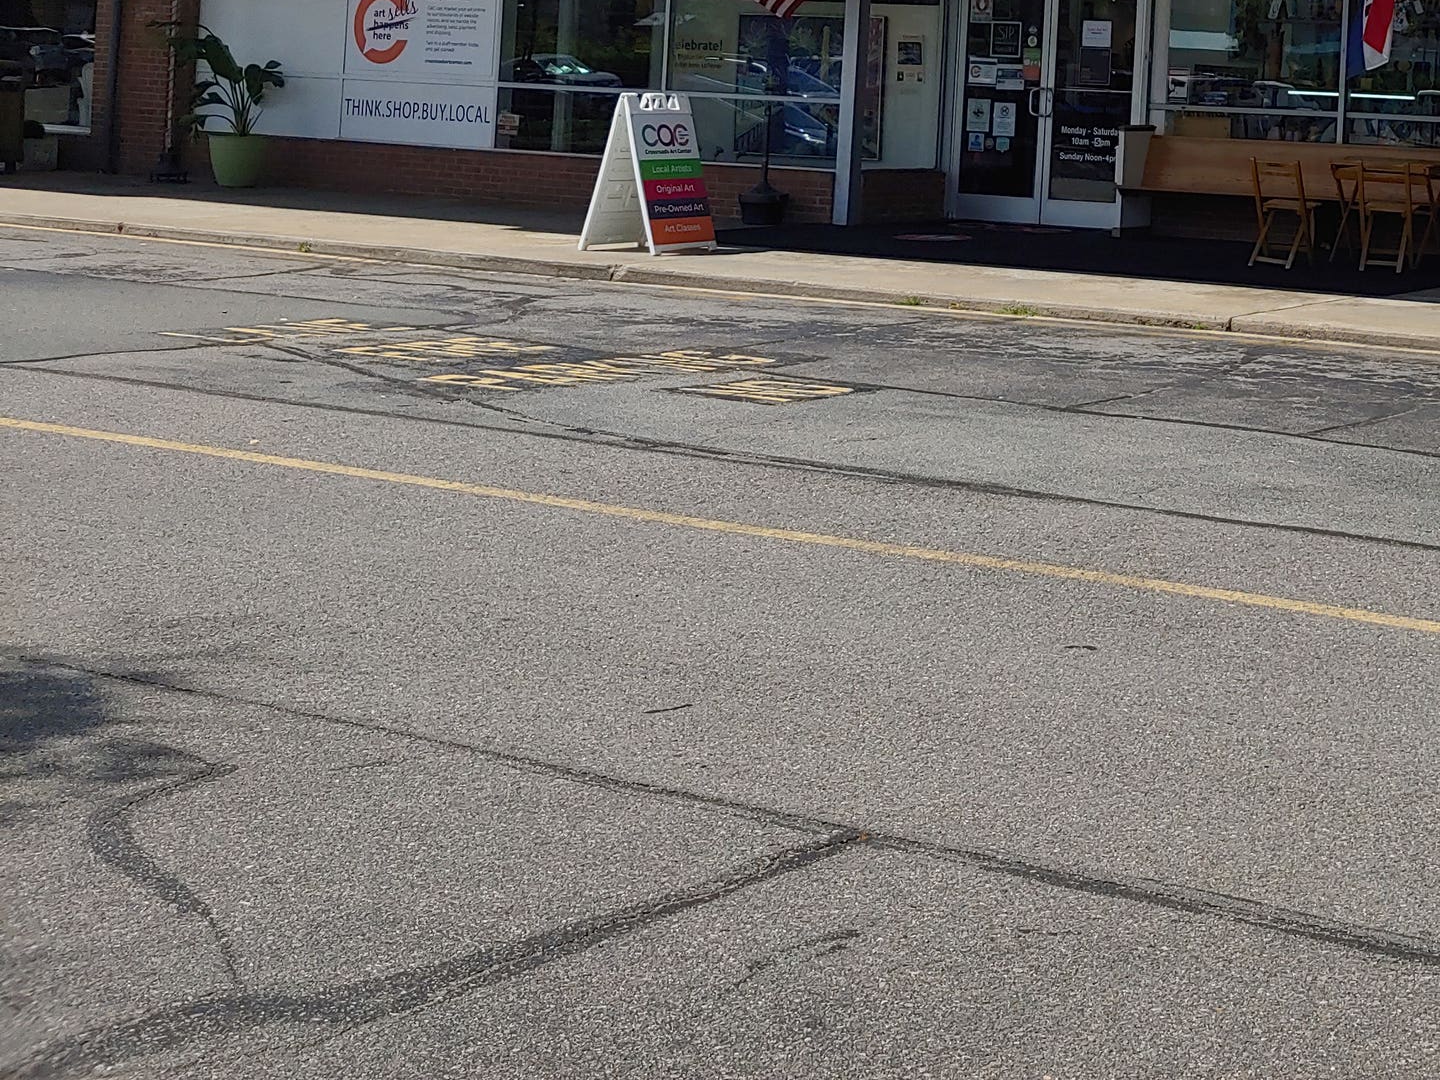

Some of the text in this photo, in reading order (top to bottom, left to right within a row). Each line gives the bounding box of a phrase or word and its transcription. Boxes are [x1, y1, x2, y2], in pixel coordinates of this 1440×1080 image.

[373, 9, 386, 18] art
[373, 19, 409, 31] happens
[372, 31, 392, 40] here
[345, 98, 490, 124] THINK.SHOP.BUY.LOCAL
[1060, 125, 1087, 136] Monday
[1071, 137, 1089, 146] 10am
[1059, 152, 1084, 162] Sunday
[652, 165, 692, 173] Local Artists
[656, 183, 695, 194] Original Art
[654, 202, 705, 213] Pre-Owned Art
[664, 223, 701, 232] Art Classes
[155, 318, 418, 343] LANE
[330, 337, 559, 361] FIRE
[416, 349, 778, 391] PARKING
[680, 378, 857, 403] NO
